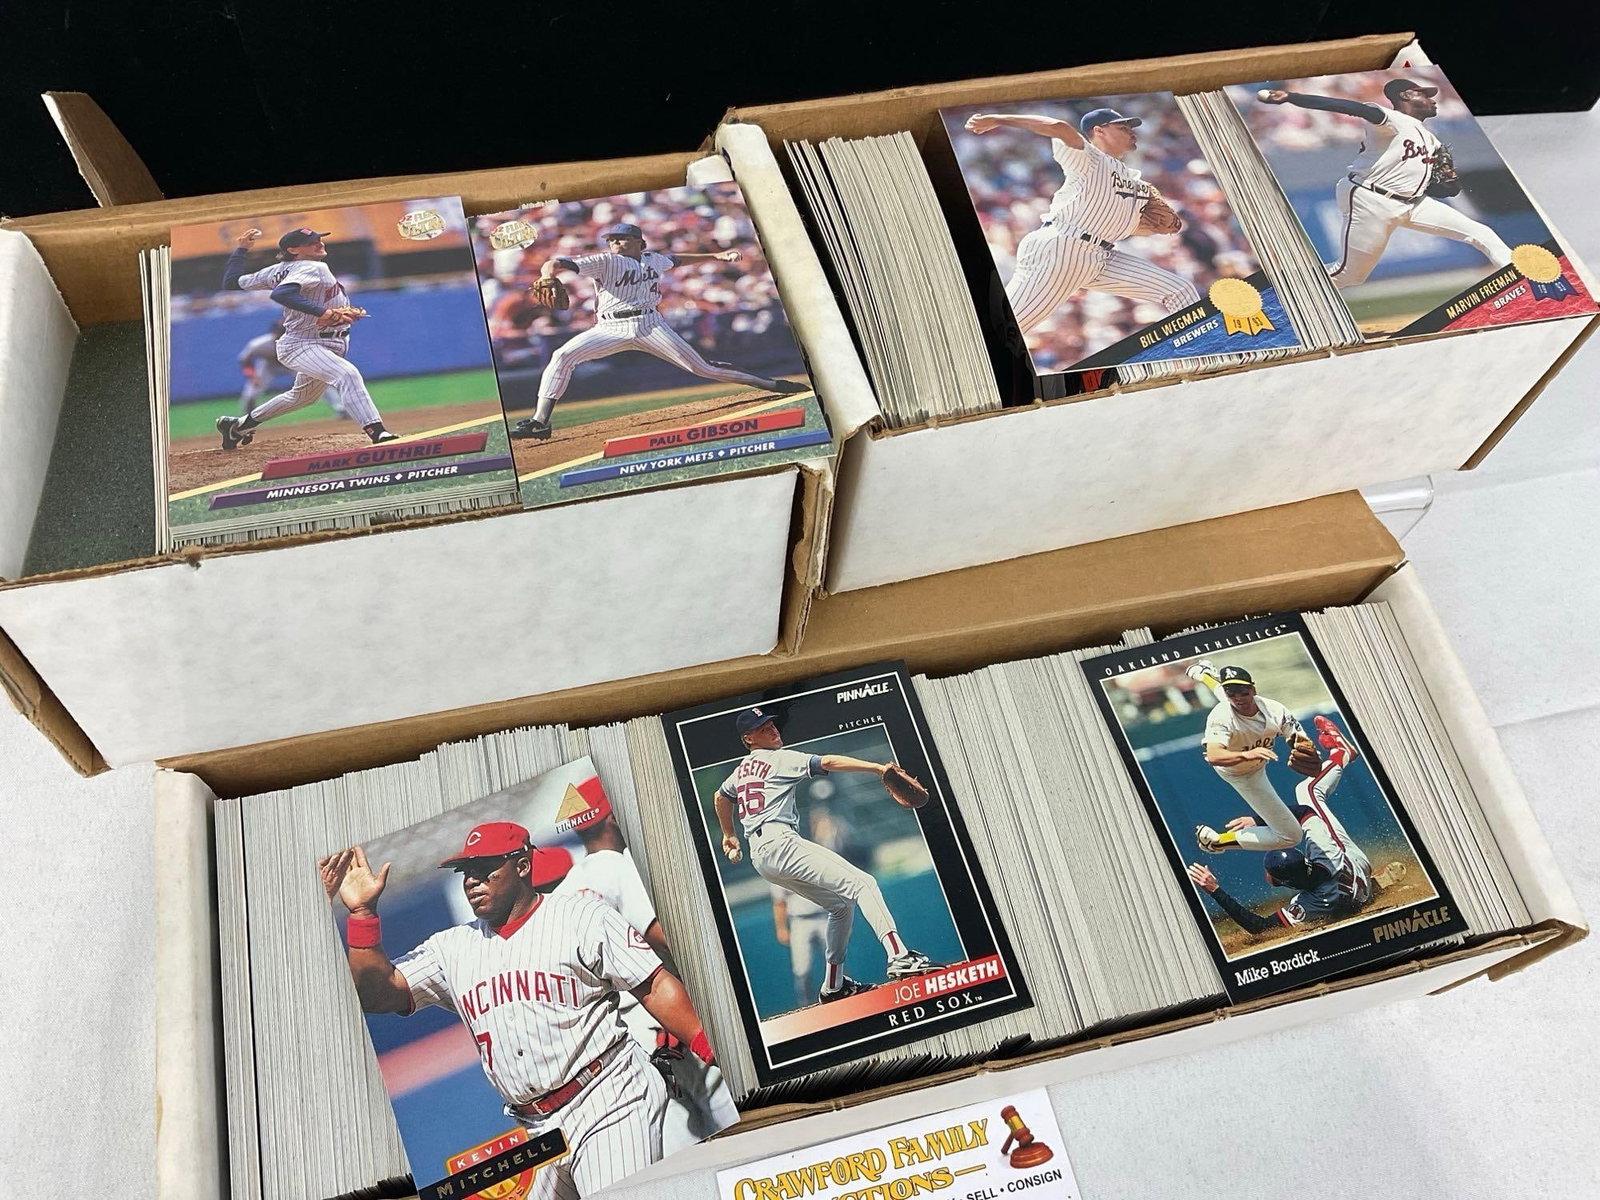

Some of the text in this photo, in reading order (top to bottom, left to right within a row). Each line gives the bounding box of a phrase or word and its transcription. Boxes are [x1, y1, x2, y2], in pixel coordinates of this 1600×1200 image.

[615, 266, 659, 287] Mets
[650, 282, 658, 296] 4
[1446, 270, 1518, 319] MARVIN FREEMAN
[1494, 285, 1527, 310] BRAVES
[1139, 307, 1206, 348] BILL WEGMAN
[1173, 319, 1219, 348] BREWERS
[650, 419, 759, 447] PAUL GIBSON
[307, 443, 443, 472] MARK GUTHRIE
[619, 442, 775, 475] NEW YORK METS PITCHER
[266, 466, 459, 499] MINNESOTA TWINS PITCHER
[1105, 650, 1181, 676] OAKLAND
[836, 681, 890, 704] PINNACLE
[838, 715, 883, 730] PITCHER
[467, 831, 481, 846] C
[1235, 905, 1451, 987] Mike Bordick PINNACLE
[461, 970, 580, 1021] NCINNATI
[894, 959, 999, 1004] JOE HESKETH
[888, 1006, 925, 1027] RED
[456, 1135, 519, 1169] KEVIN
[734, 1118, 989, 1200] CRAWFORD FAMILY
[436, 1142, 552, 1199] MITCHELL
[966, 1168, 1063, 1200] SELL CONSIGN
